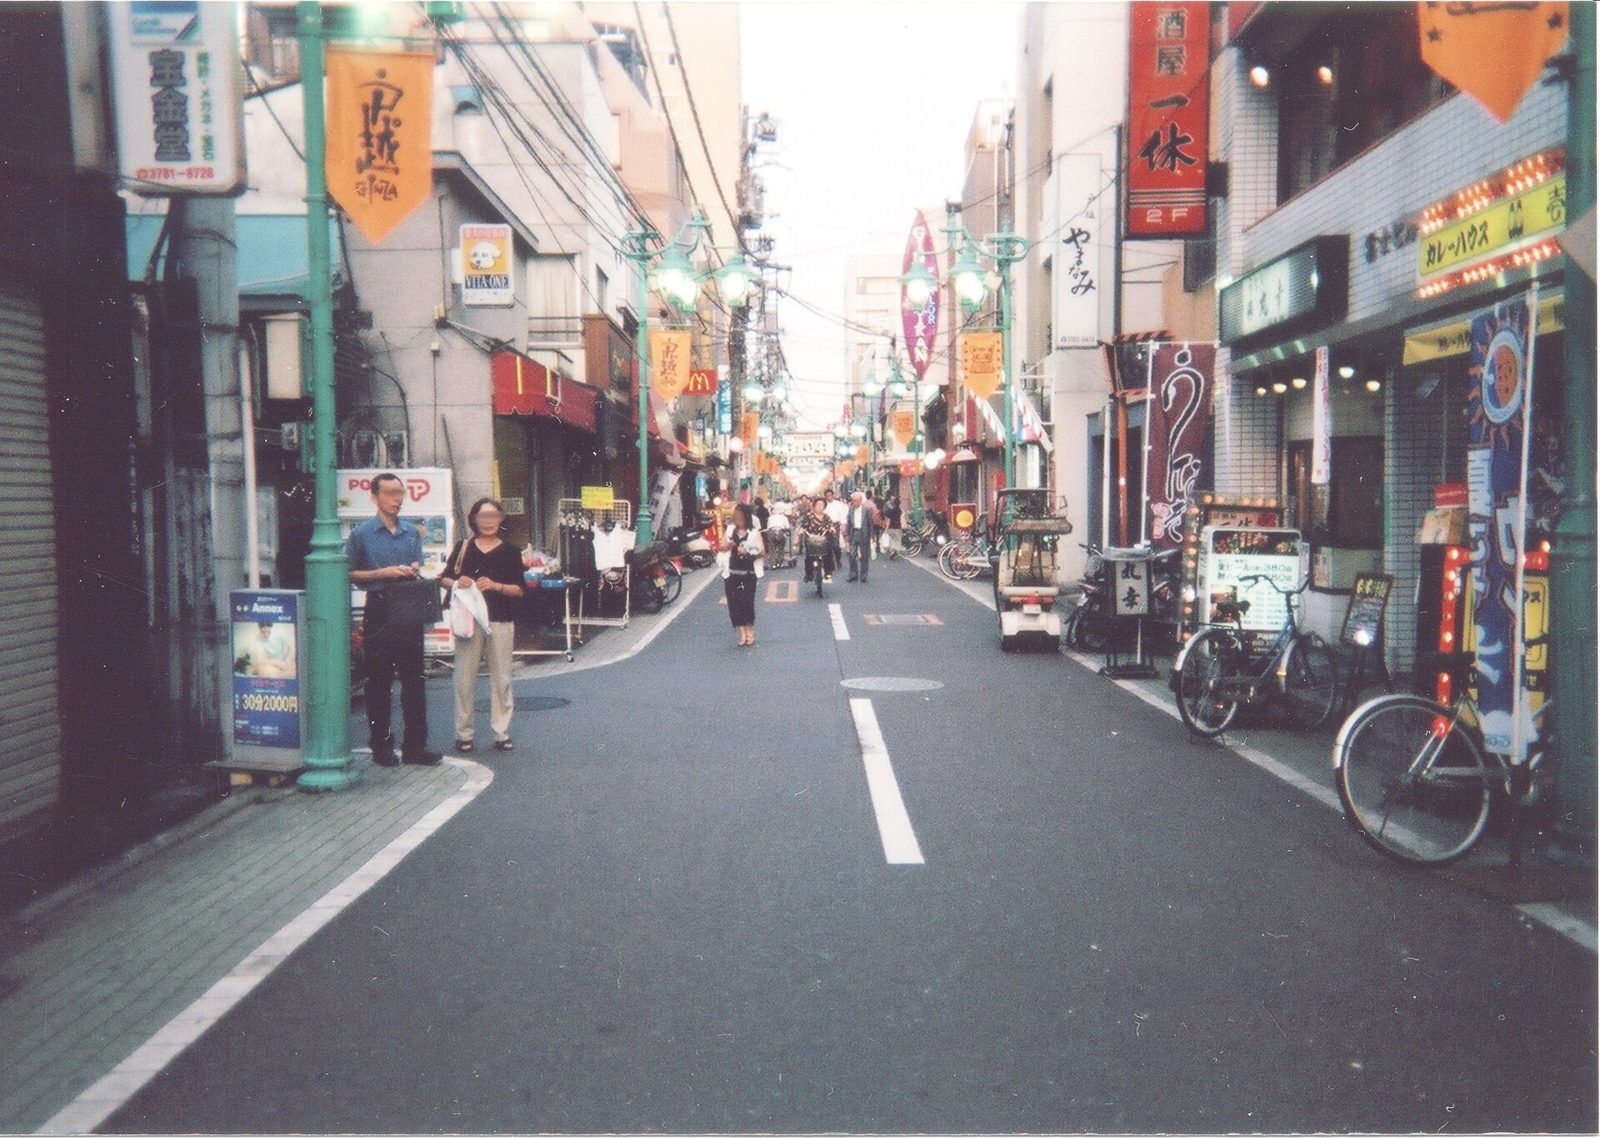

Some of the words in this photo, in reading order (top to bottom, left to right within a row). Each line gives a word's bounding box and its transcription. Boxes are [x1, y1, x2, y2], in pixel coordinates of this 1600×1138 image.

[1138, 93, 1199, 172] 一休
[1062, 227, 1096, 296] やまなみ
[1426, 220, 1489, 268] カレーハウス
[252, 603, 283, 614] Annex
[242, 694, 299, 713] 30分2000円
